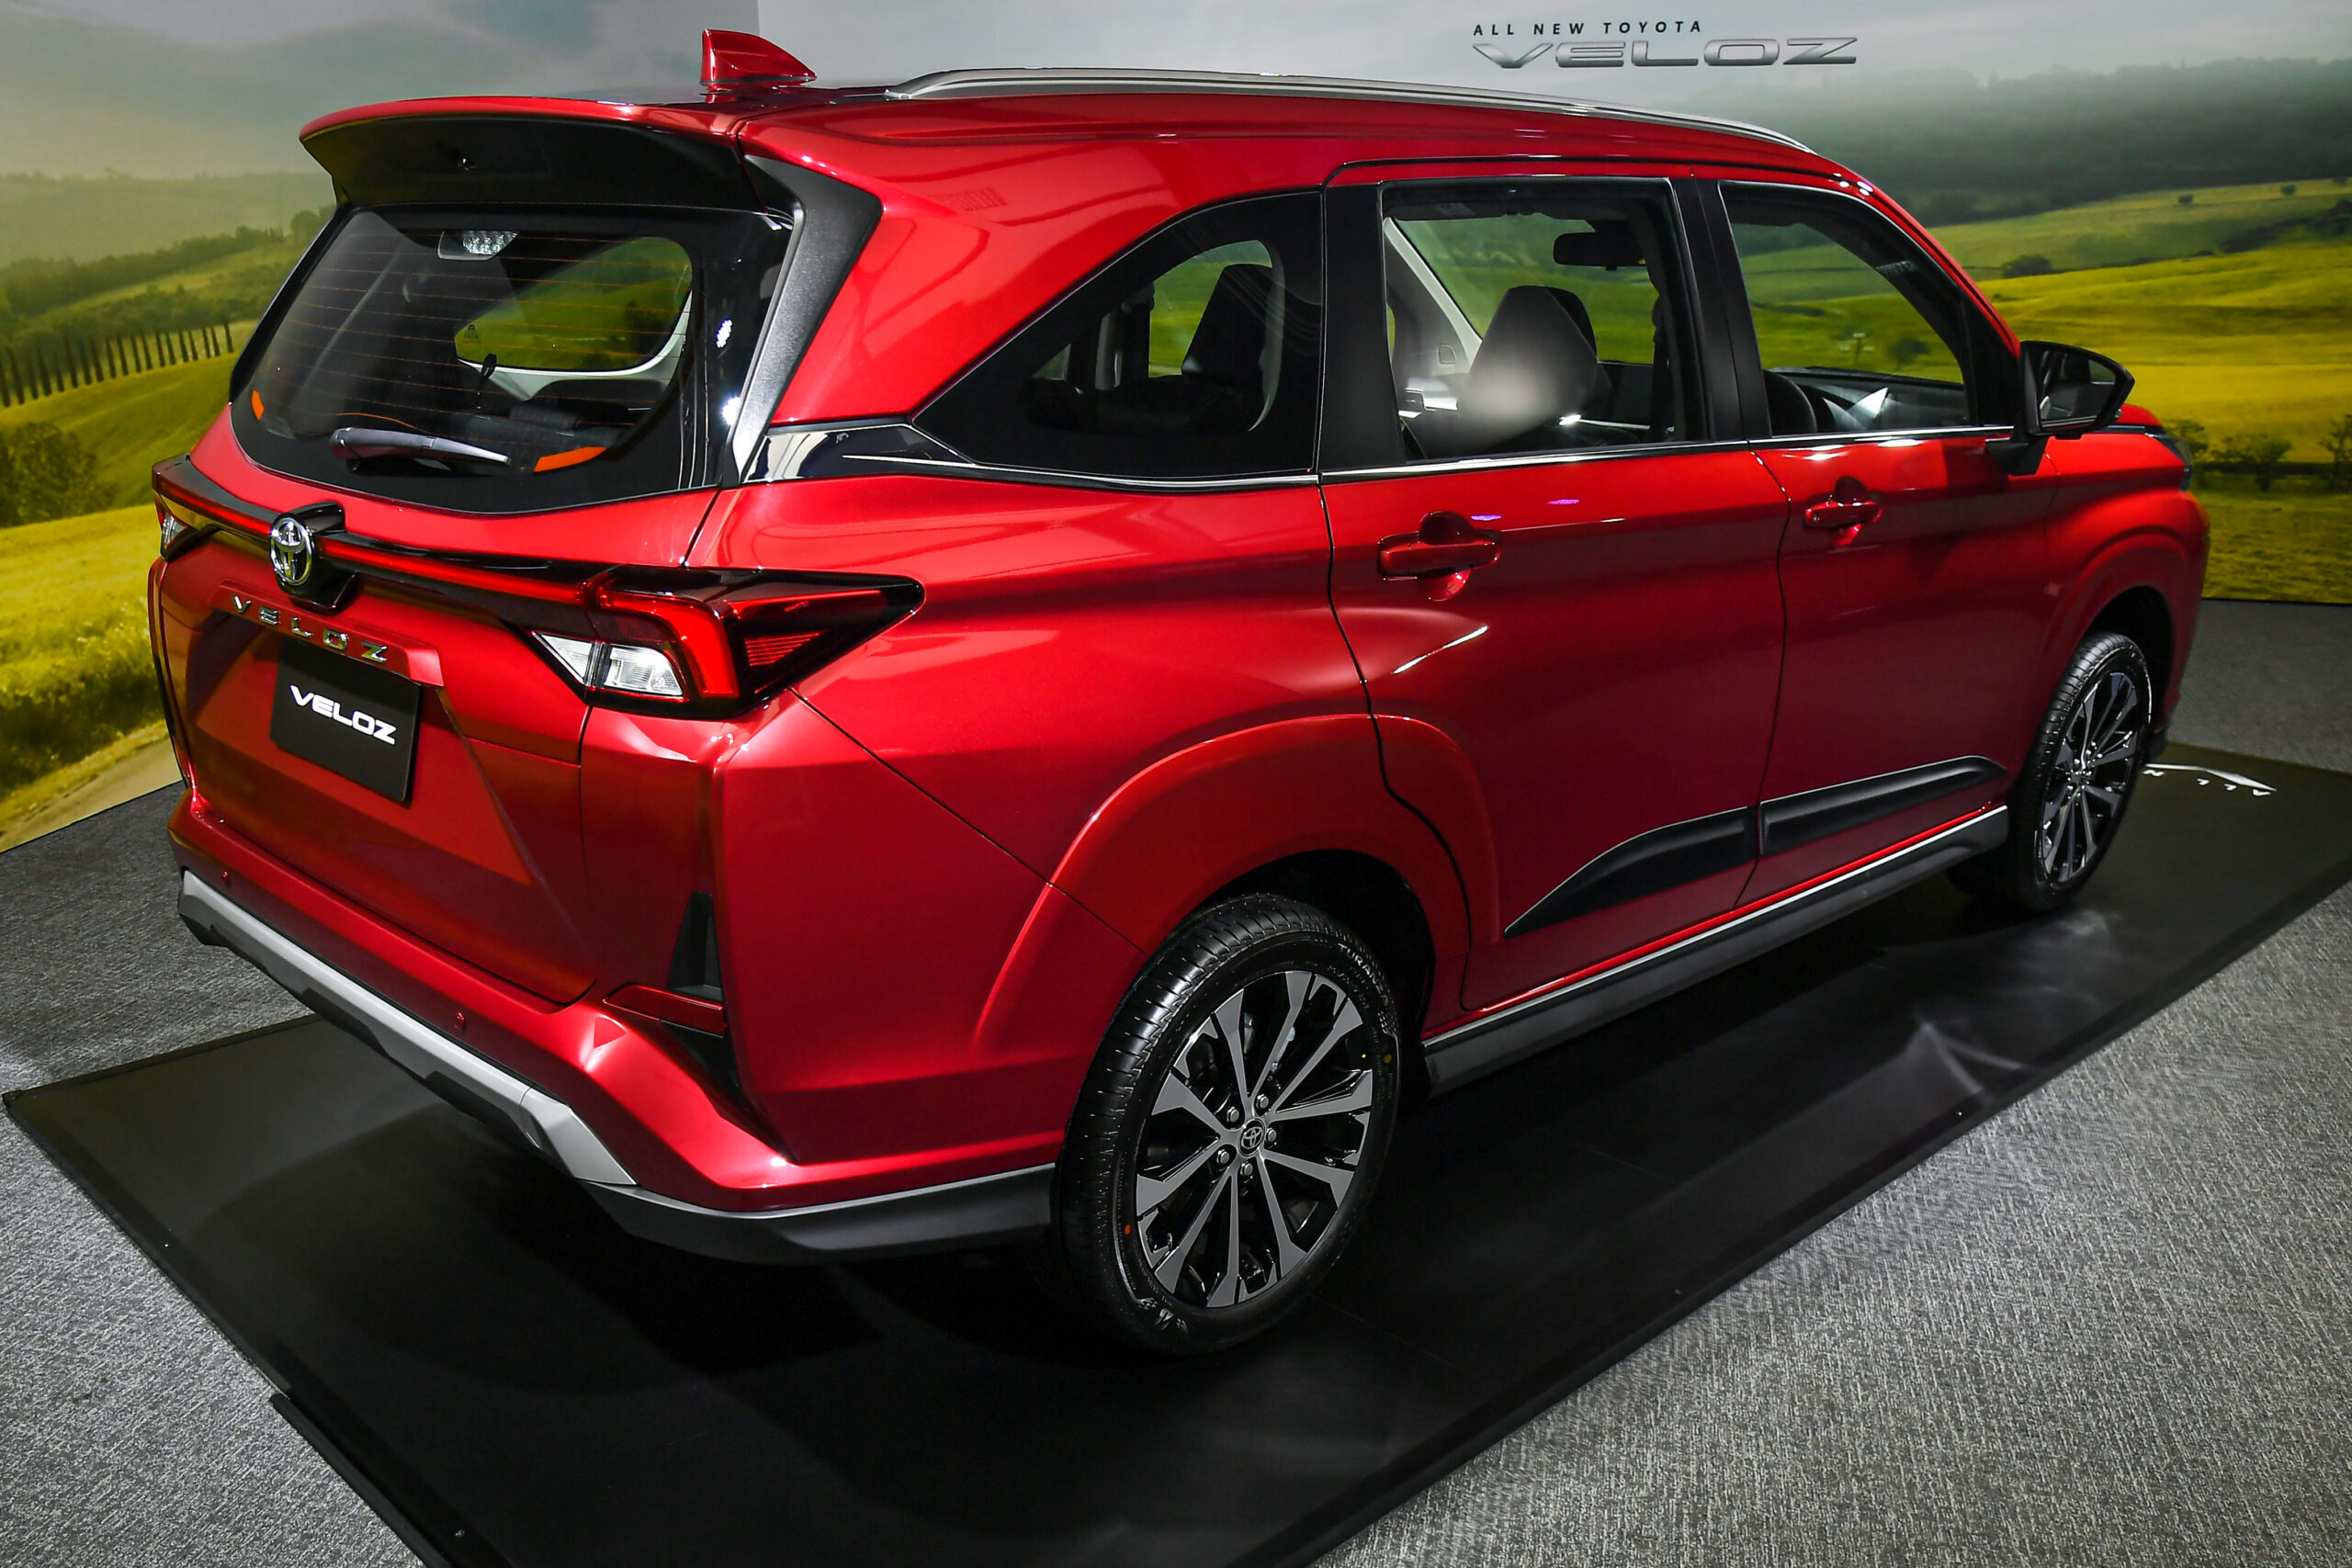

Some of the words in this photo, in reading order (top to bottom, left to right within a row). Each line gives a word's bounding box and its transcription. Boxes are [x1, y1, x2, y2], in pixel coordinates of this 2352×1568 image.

[1472, 37, 1858, 69] VELOZ
[1473, 24, 1515, 36] ALL
[1533, 23, 1585, 35] NEW
[1603, 20, 1702, 35] TOYOTA
[232, 595, 388, 664] VELOZ
[289, 684, 397, 745] VELOZ
[1337, 942, 1388, 1009] TURANZA
